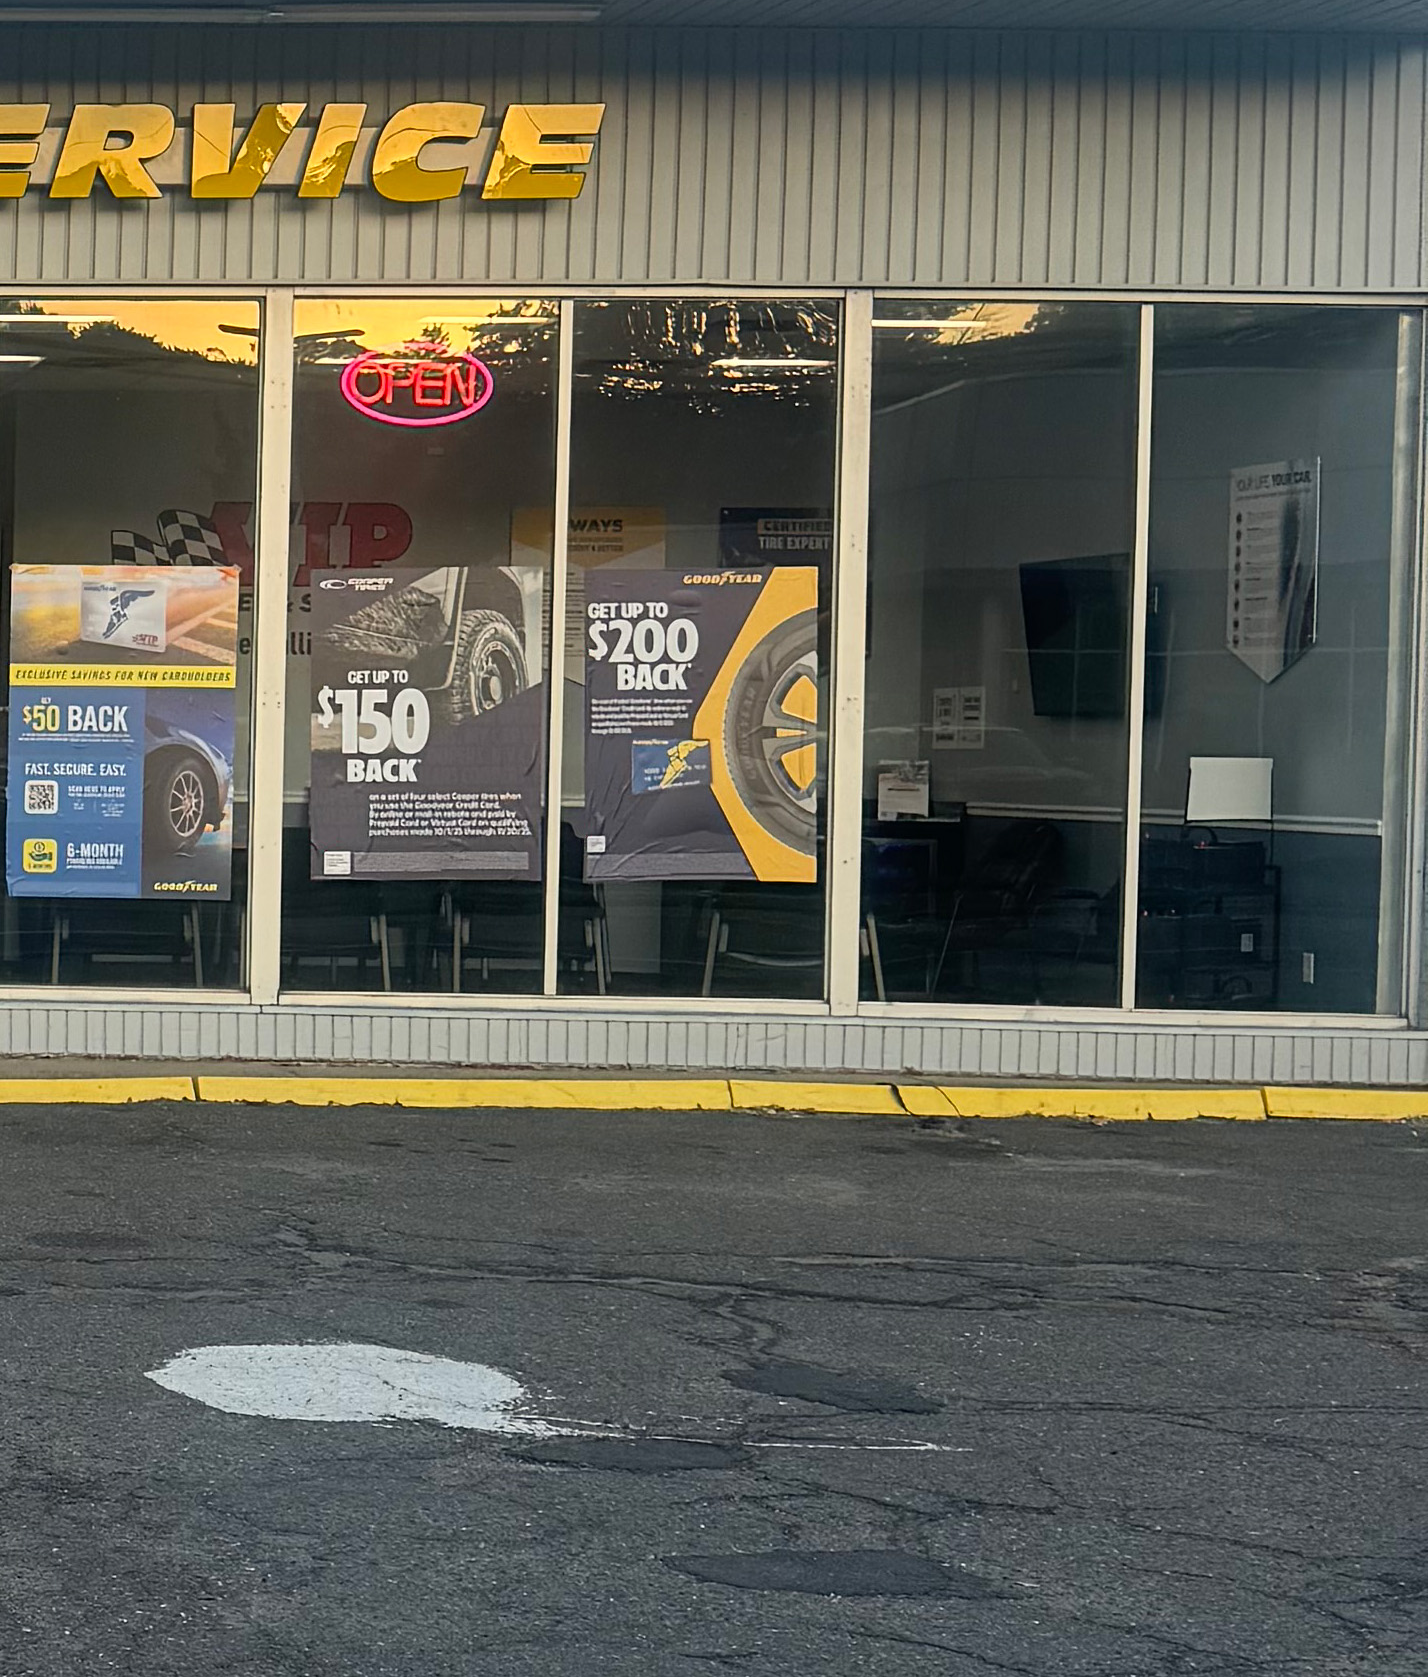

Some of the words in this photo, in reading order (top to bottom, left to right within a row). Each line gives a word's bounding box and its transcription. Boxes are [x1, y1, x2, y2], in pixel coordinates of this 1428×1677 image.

[350, 361, 476, 407] OPEN
[758, 536, 783, 550] TIRE
[683, 571, 763, 586] GOODYEAR
[588, 603, 618, 619] GET
[621, 603, 644, 619] UP
[646, 602, 669, 618] TO
[588, 618, 699, 663] $200
[15, 669, 67, 680] EXCLUSIVE
[71, 670, 111, 680] SAVINGS
[114, 671, 134, 681] FOR
[137, 671, 158, 681] NEW
[162, 671, 231, 682] CARDHOLDERS
[348, 670, 371, 684] GET
[372, 670, 390, 684] UP
[392, 670, 408, 683] TO
[22, 705, 60, 732] $50
[67, 705, 129, 732] BACK
[318, 685, 430, 755] $150
[25, 763, 51, 776] FAST.
[53, 763, 97, 776] SECURE.
[99, 764, 127, 776] EASY.
[67, 843, 124, 858] 6-MONTH
[154, 880, 218, 893] GOODYEAR
